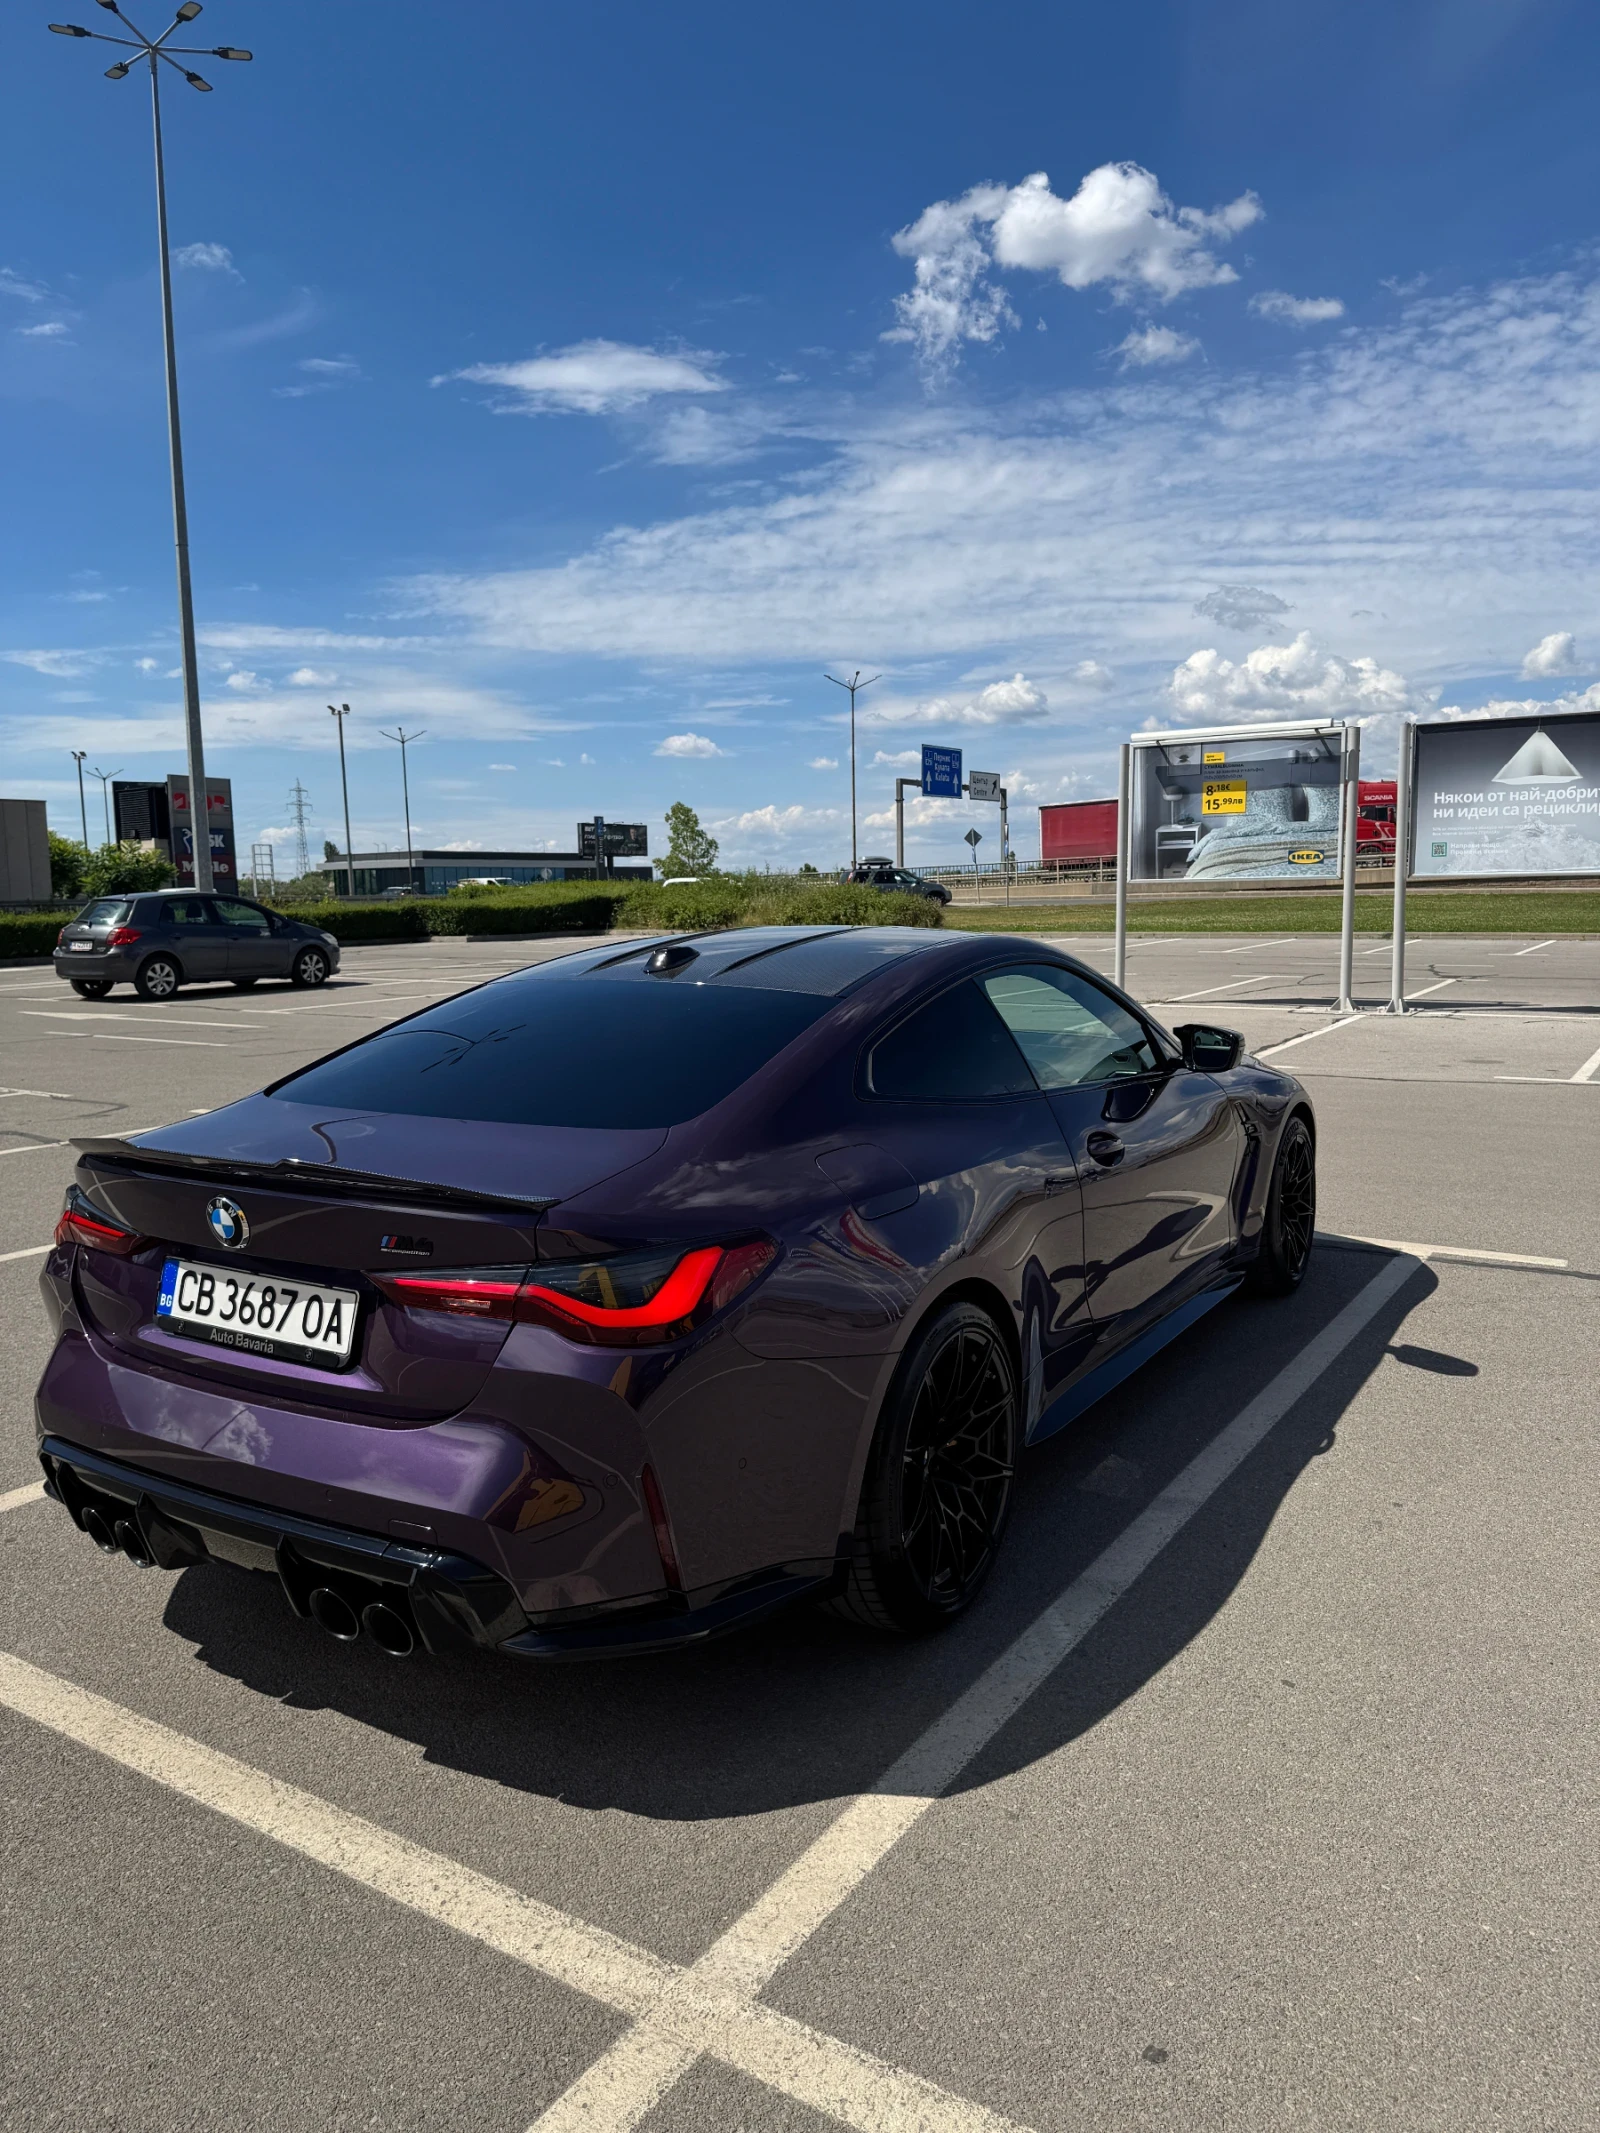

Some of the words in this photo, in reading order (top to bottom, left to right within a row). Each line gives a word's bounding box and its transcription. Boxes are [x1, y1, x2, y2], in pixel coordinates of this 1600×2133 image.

[1434, 792, 1484, 804] Някои
[1487, 792, 1506, 802] от
[1510, 785, 1600, 802] най-добри
[1433, 808, 1454, 818] ни
[1457, 806, 1499, 820] идеи
[1502, 805, 1520, 816] са
[182, 861, 229, 873] Mle
[160, 1293, 173, 1308] BG
[178, 1269, 217, 1317] CB
[219, 1278, 299, 1333] 3687
[209, 1328, 235, 1345] Auto
[235, 1333, 275, 1354] Bavaria
